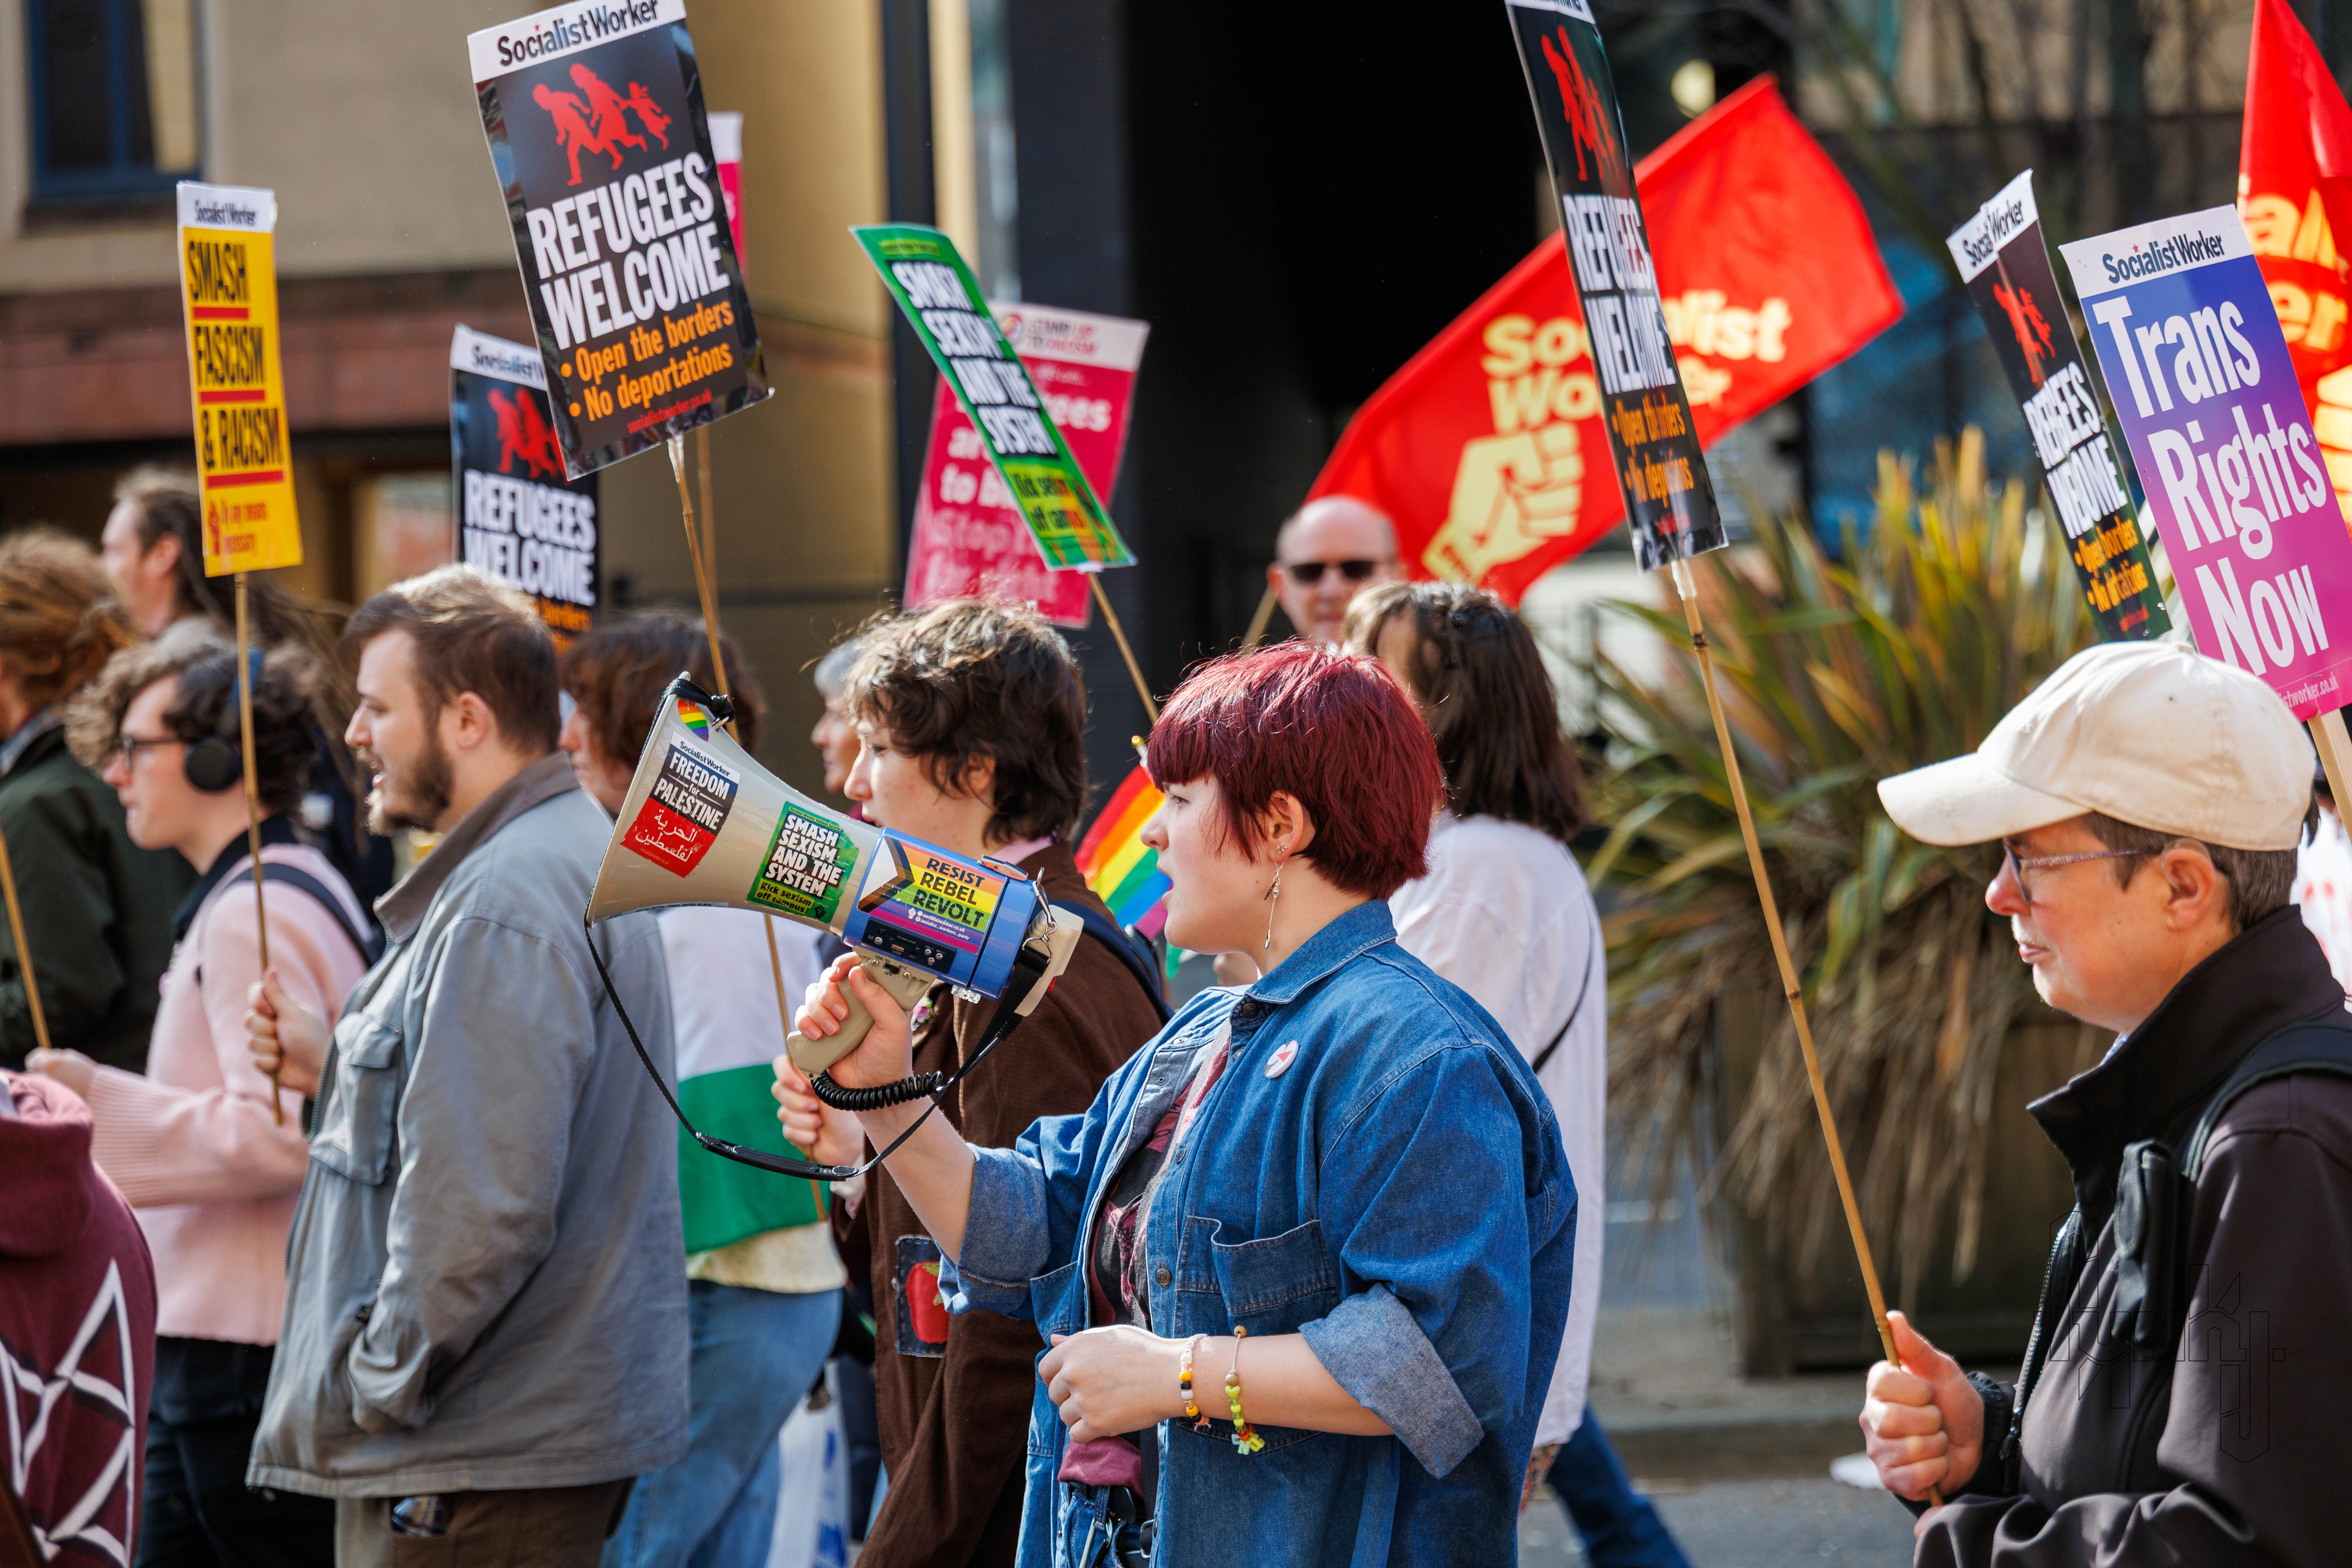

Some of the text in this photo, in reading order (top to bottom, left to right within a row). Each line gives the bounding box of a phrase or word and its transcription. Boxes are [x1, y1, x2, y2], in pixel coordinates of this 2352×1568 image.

[526, 151, 714, 279] REFUGEES
[188, 240, 250, 305] SMASH
[539, 221, 731, 350] WELCOME
[193, 325, 267, 387] FASCISM
[575, 300, 734, 385] Open the borders
[2092, 296, 2261, 418] Trans
[583, 342, 733, 421] No deportations
[202, 407, 284, 470] & RACISM
[2147, 403, 2327, 560] Rights
[464, 468, 597, 553] REFUGEES
[2194, 556, 2329, 676] Now
[2278, 671, 2339, 708] stworker.co.uk
[669, 751, 730, 800] FREEDOM
[688, 783, 701, 796] for
[653, 777, 724, 830] PALESTINE
[790, 807, 803, 817] Socialist
[803, 813, 815, 821] Worker
[816, 818, 828, 827] Student
[654, 809, 698, 843] الحرية
[784, 814, 839, 847] SMASH
[635, 829, 693, 862] لفلسطين
[778, 829, 837, 864] SEXISM
[765, 862, 826, 897] SYSTEM
[771, 846, 842, 885] AND THE
[926, 858, 985, 887] RESIST
[757, 892, 805, 912] off campus
[760, 882, 812, 906] Kick sexism
[912, 889, 985, 927] REVOLT
[920, 872, 977, 906] REBEL
[922, 913, 965, 933] socialistworker.co.uk
